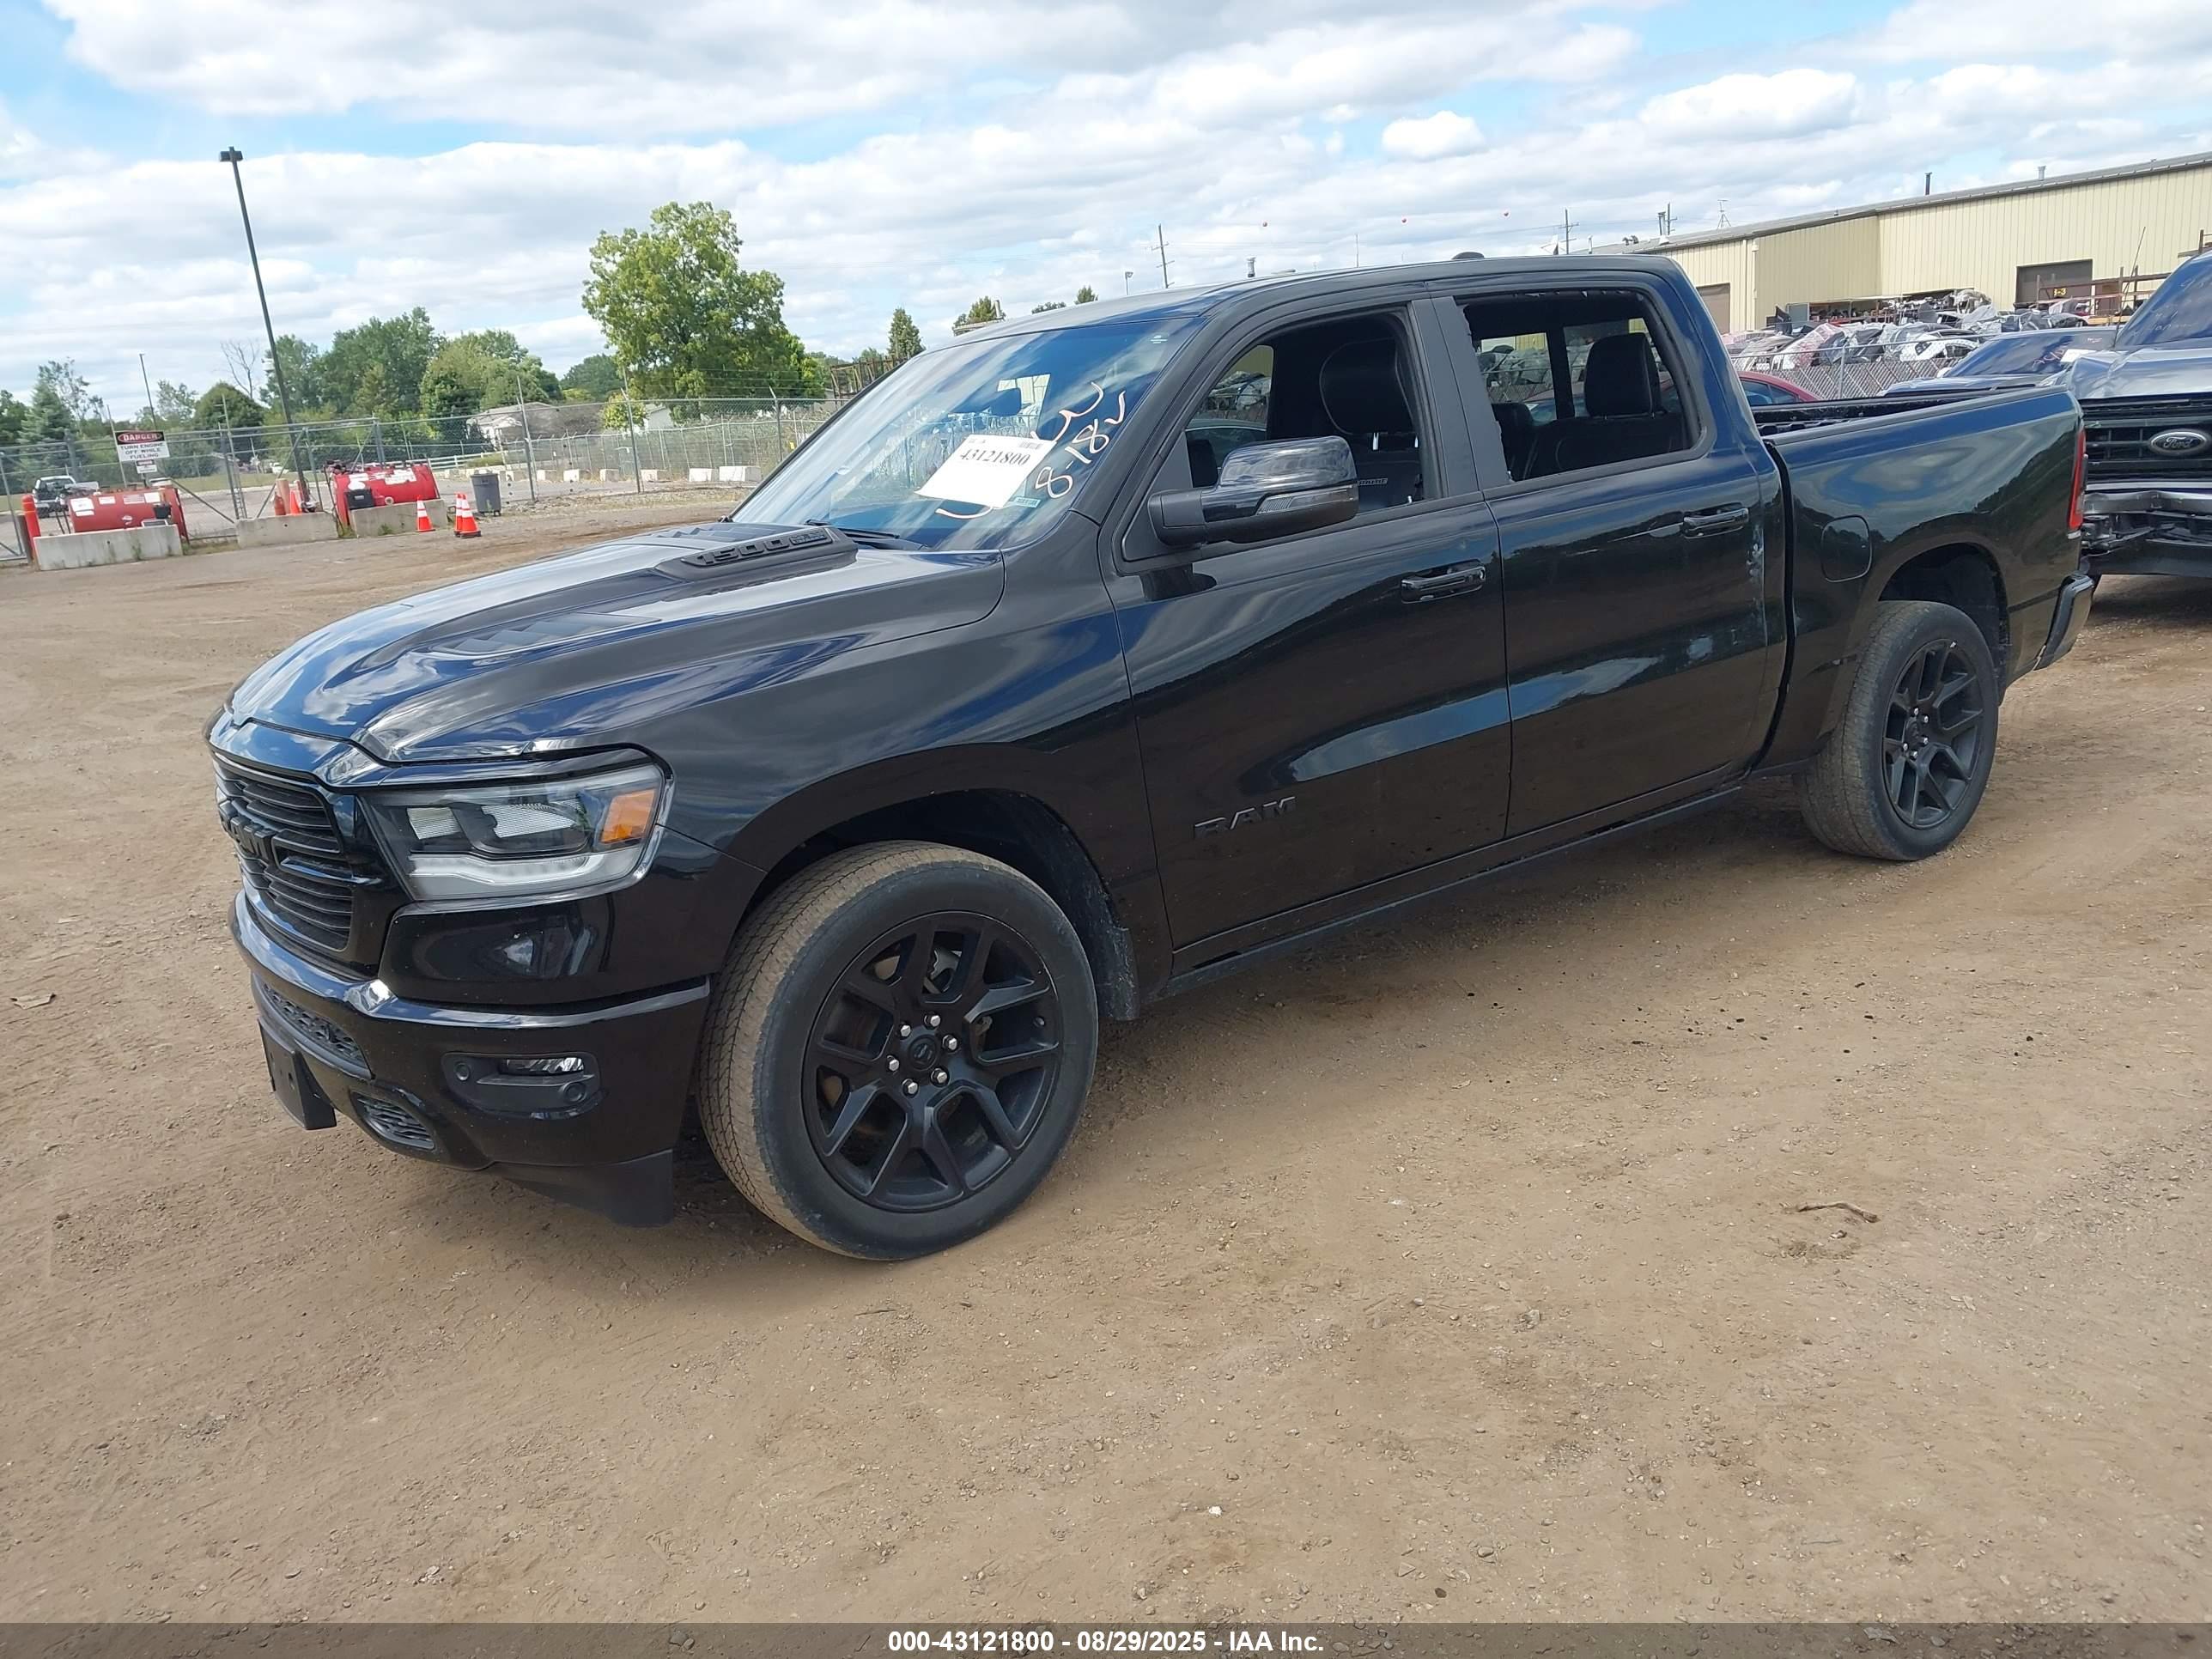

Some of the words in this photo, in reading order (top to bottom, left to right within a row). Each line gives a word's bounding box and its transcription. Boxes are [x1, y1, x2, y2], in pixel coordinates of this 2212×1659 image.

[123, 433, 158, 441] DANGER
[2162, 436, 2195, 448] Ford
[959, 448, 1031, 465] 43121800
[696, 537, 790, 565] 1500
[1193, 795, 1296, 839] RAM
